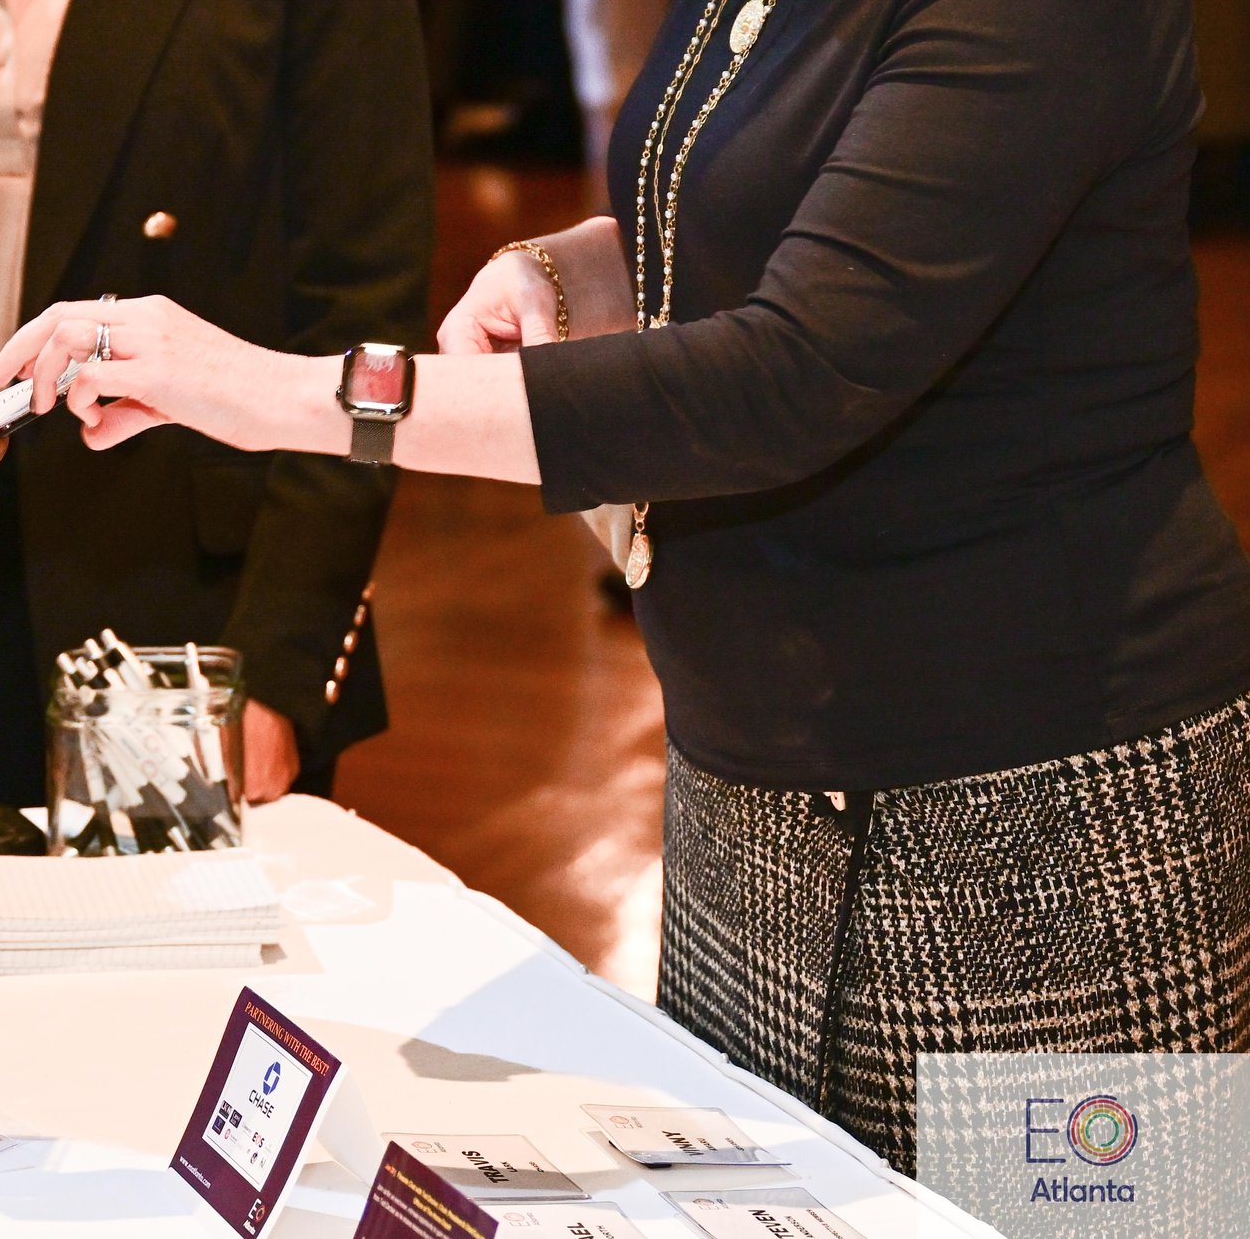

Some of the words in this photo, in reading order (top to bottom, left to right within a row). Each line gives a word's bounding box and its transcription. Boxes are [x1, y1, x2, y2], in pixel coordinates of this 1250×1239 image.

[244, 1001, 286, 1040] PARTNERING
[283, 1031, 302, 1054] WITH
[299, 1043, 314, 1063] THE
[310, 1054, 330, 1077] BEST!
[248, 1089, 275, 1119] CHASE
[661, 1130, 705, 1157] VINNY
[461, 1150, 510, 1184] TRAVIS
